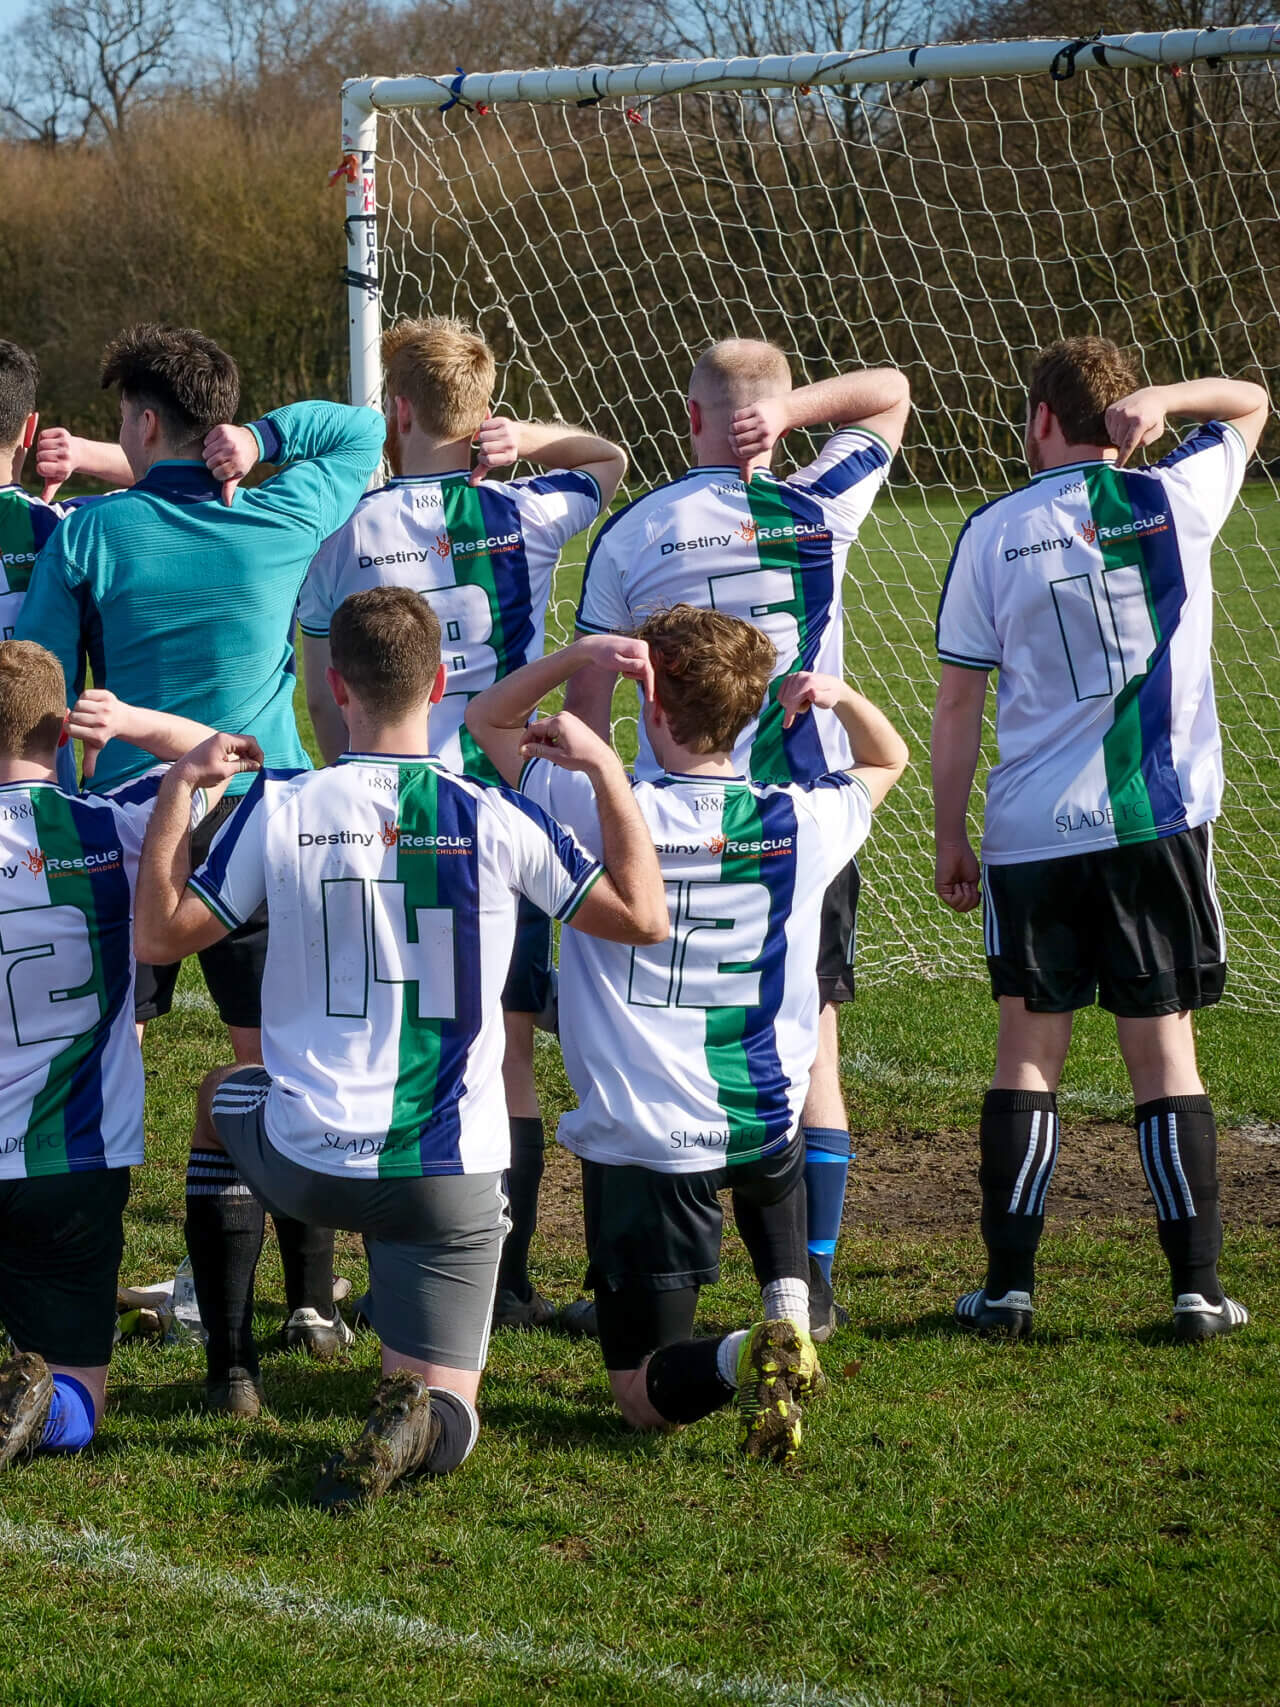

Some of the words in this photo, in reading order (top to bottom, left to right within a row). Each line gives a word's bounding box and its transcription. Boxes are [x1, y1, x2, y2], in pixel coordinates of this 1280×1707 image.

[358, 550, 429, 569] Destiny
[452, 533, 519, 554] Rescue
[661, 533, 732, 557] Destiny
[757, 523, 826, 539] Rescue
[1004, 534, 1074, 562] Destiny
[1098, 514, 1165, 539] Rescue
[2, 552, 36, 565] Res
[1049, 564, 1161, 703] 11
[1055, 808, 1117, 833] SLADE
[1121, 801, 1147, 820] FC
[298, 829, 374, 848] Destiny
[399, 834, 472, 847] Rescue
[655, 843, 700, 855] stiny
[726, 837, 792, 853] Rescue
[46, 850, 118, 871] Rescue
[321, 878, 458, 1020] 14
[628, 880, 773, 1009] 12
[36, 1133, 62, 1151] FC
[670, 1130, 733, 1148] SLADE
[741, 1126, 763, 1144] FC
